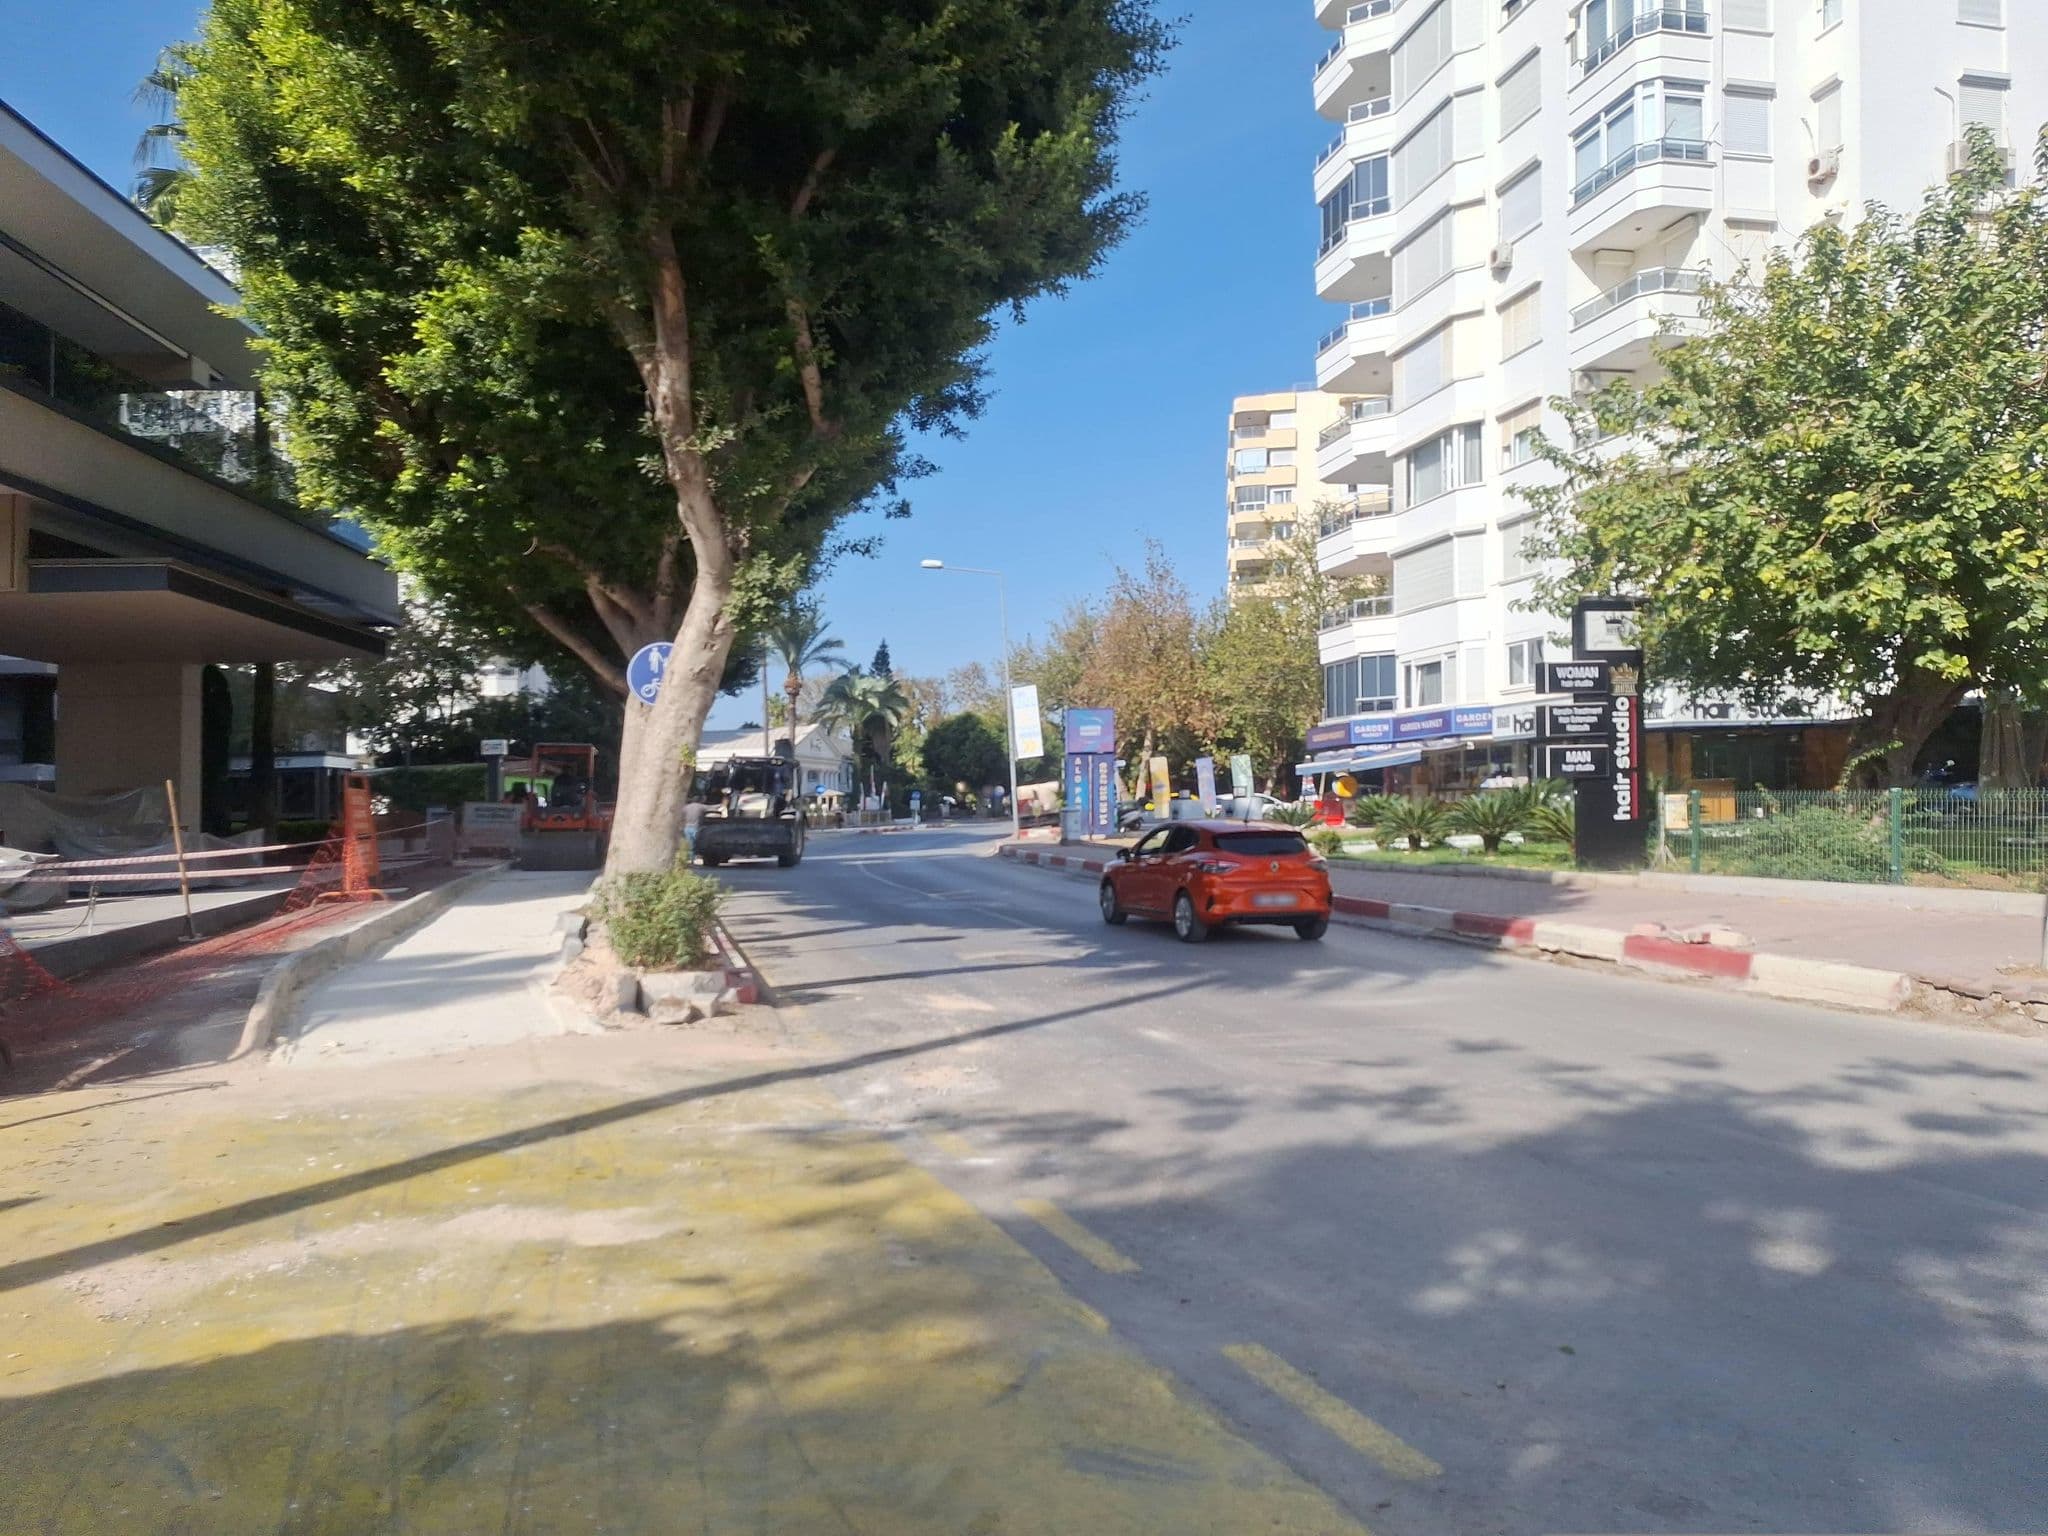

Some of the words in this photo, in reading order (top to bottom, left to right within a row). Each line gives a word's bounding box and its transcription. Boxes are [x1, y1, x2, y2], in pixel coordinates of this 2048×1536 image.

[1556, 666, 1599, 678] WOMAN
[1354, 724, 1389, 734] GARDEN
[1612, 697, 1630, 769] studio
[1566, 750, 1591, 763] MAN
[1613, 773, 1631, 820] hair
